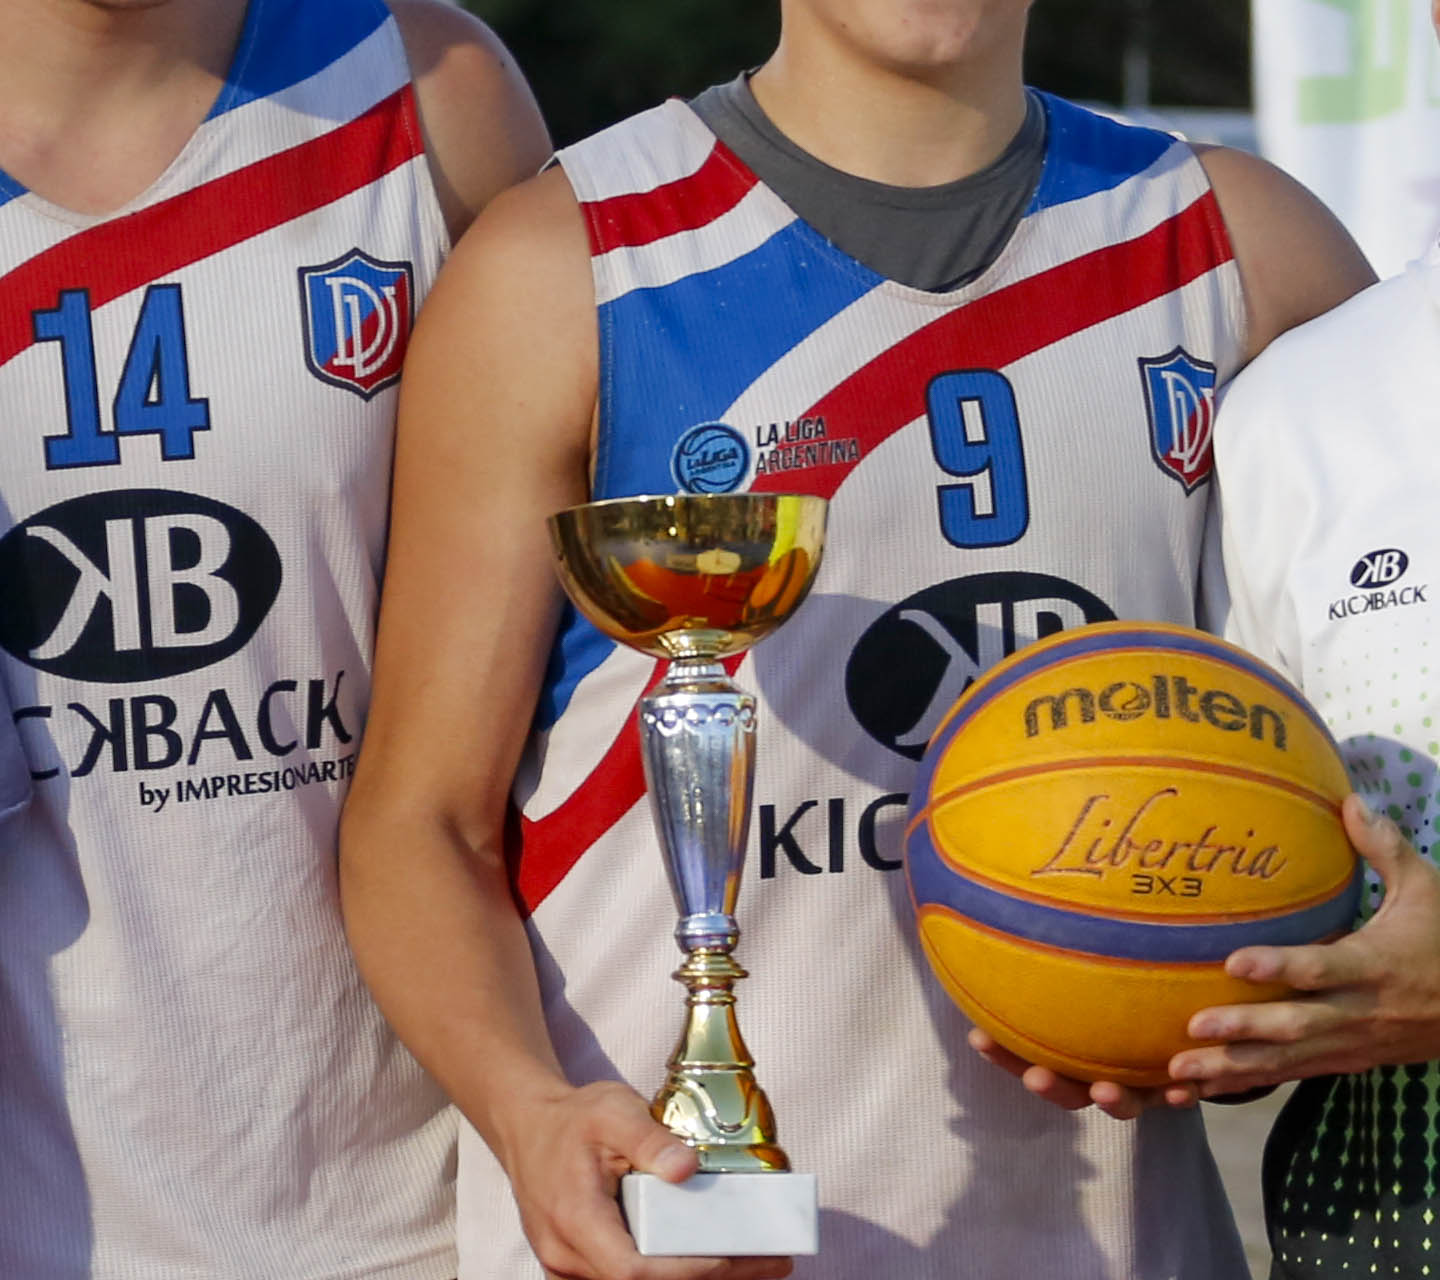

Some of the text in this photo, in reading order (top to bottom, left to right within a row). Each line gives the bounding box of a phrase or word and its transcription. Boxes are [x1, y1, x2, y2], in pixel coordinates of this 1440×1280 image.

[31, 283, 210, 471] 14
[755, 438, 861, 475] ARGENTINA
[756, 416, 827, 448] LA LIGA
[926, 368, 1031, 549] 9
[1329, 584, 1428, 621] KICKBACK
[1024, 674, 1287, 752] molten
[139, 782, 169, 812] by
[1030, 787, 1287, 880] Libertria
